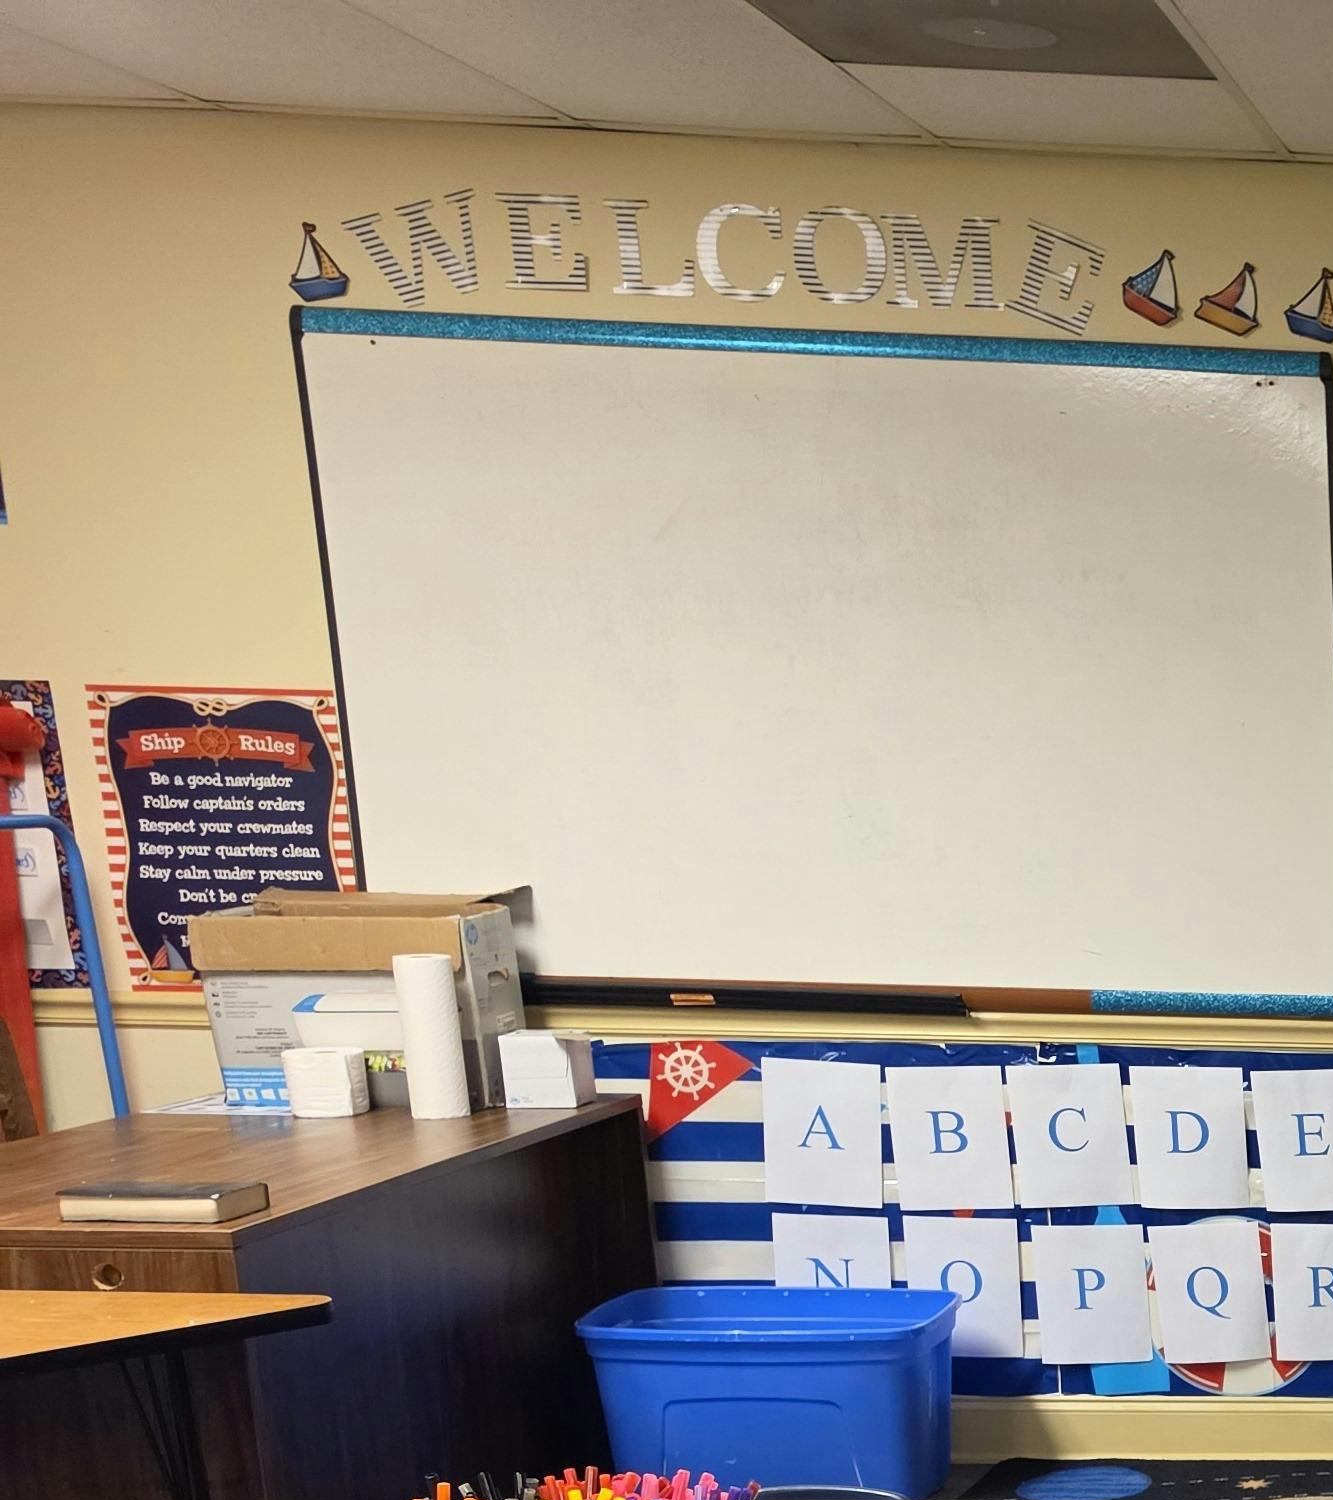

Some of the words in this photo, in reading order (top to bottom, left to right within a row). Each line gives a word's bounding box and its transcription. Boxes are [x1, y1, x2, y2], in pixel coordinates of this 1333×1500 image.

[342, 188, 1106, 335] WELCOME
[140, 733, 185, 753] Ship
[238, 734, 296, 756] Rules
[149, 772, 170, 786] Be
[174, 774, 184, 786] a
[187, 772, 224, 789] good
[224, 773, 293, 789] navigator
[142, 795, 189, 810] Follow
[193, 796, 254, 813] captain's
[258, 797, 306, 812] orders
[138, 819, 196, 836] Respect
[199, 821, 233, 837] your
[237, 820, 314, 836] crewmates
[138, 842, 175, 858] Keep
[177, 844, 212, 860] your
[215, 844, 278, 861] quarters
[281, 843, 321, 859] clean
[139, 865, 172, 883] Stay
[175, 866, 211, 881] calm
[213, 866, 256, 881] under
[260, 869, 324, 884] pressure
[178, 888, 217, 904] Don't
[219, 889, 238, 904] be
[798, 1106, 845, 1150] A
[925, 1110, 969, 1154] B
[1048, 1107, 1090, 1153] C
[1166, 1110, 1210, 1154] D
[1291, 1113, 1331, 1157] E
[806, 1257, 855, 1288] N
[940, 1259, 982, 1303] O
[1070, 1267, 1105, 1310] P
[1186, 1265, 1231, 1319] Q
